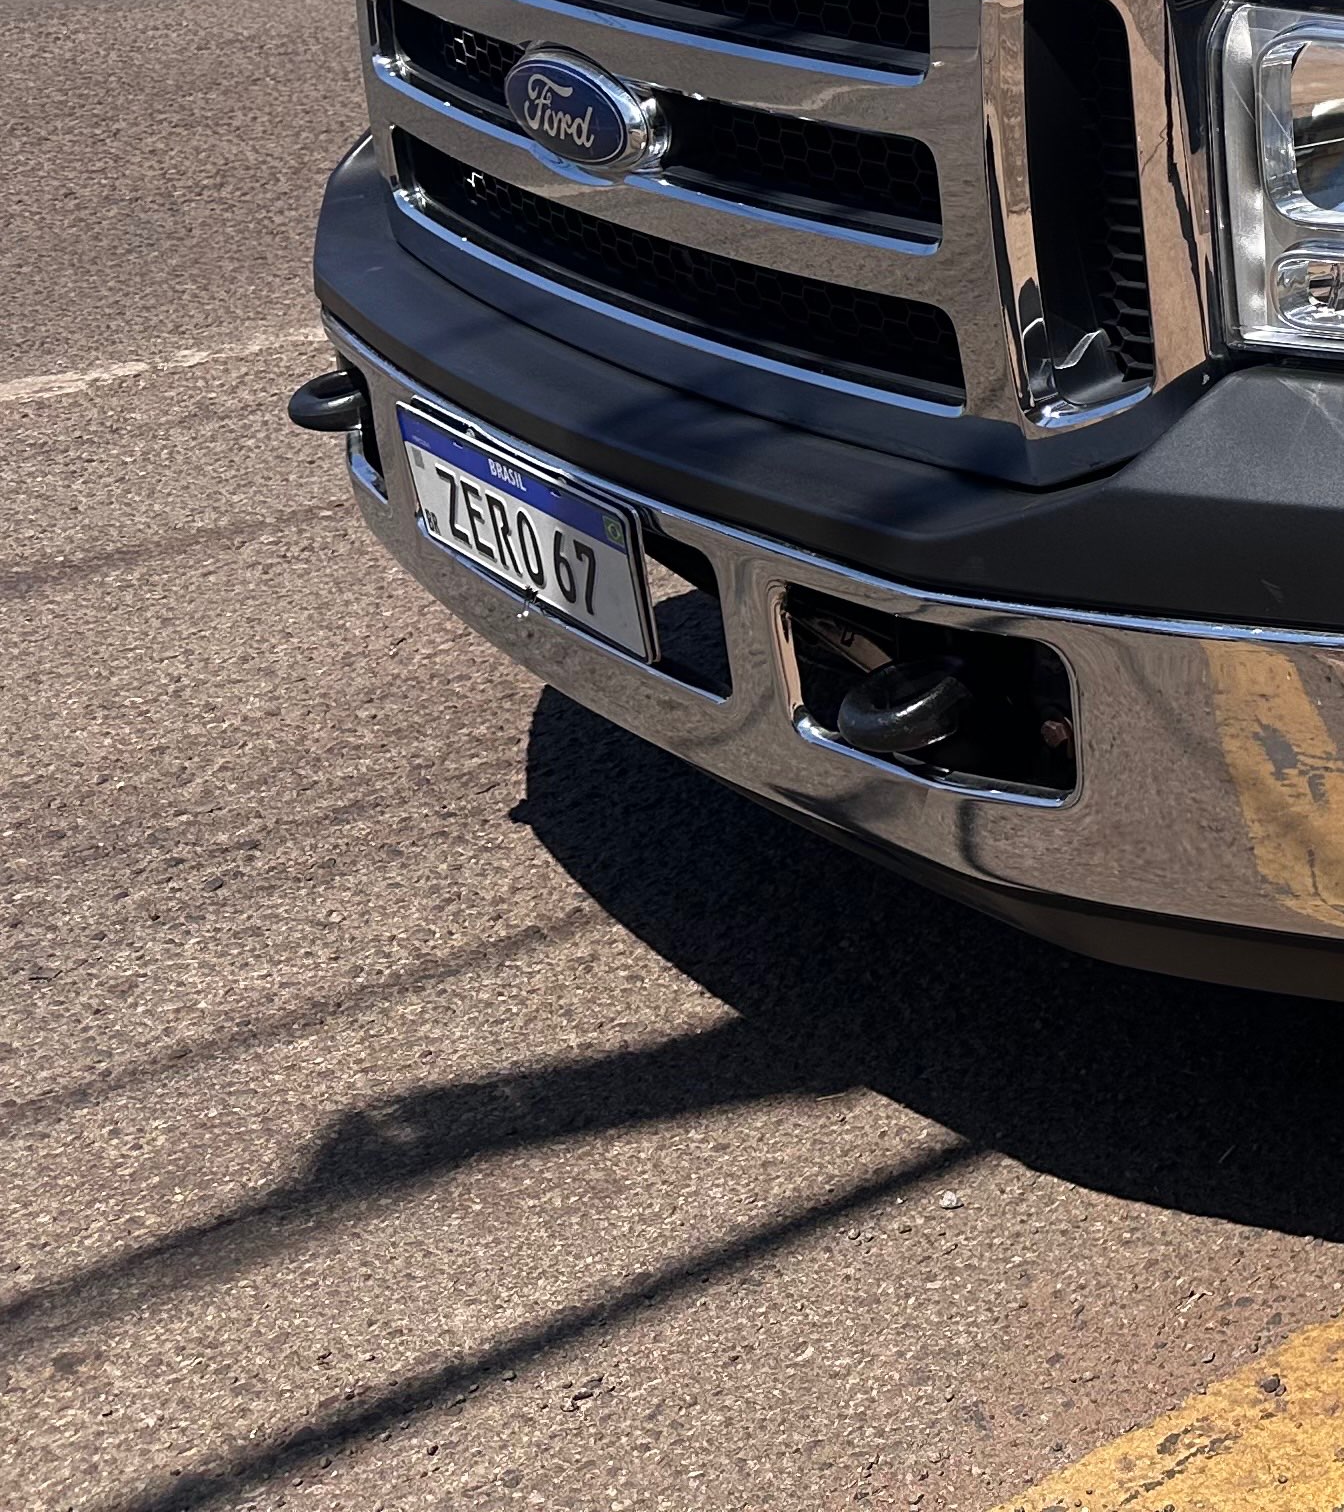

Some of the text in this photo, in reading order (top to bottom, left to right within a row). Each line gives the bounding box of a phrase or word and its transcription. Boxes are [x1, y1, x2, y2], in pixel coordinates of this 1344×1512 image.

[523, 73, 594, 149] Ford
[487, 458, 527, 491] BRASIL
[425, 507, 441, 536] BR
[434, 463, 596, 616] ZERO 67
